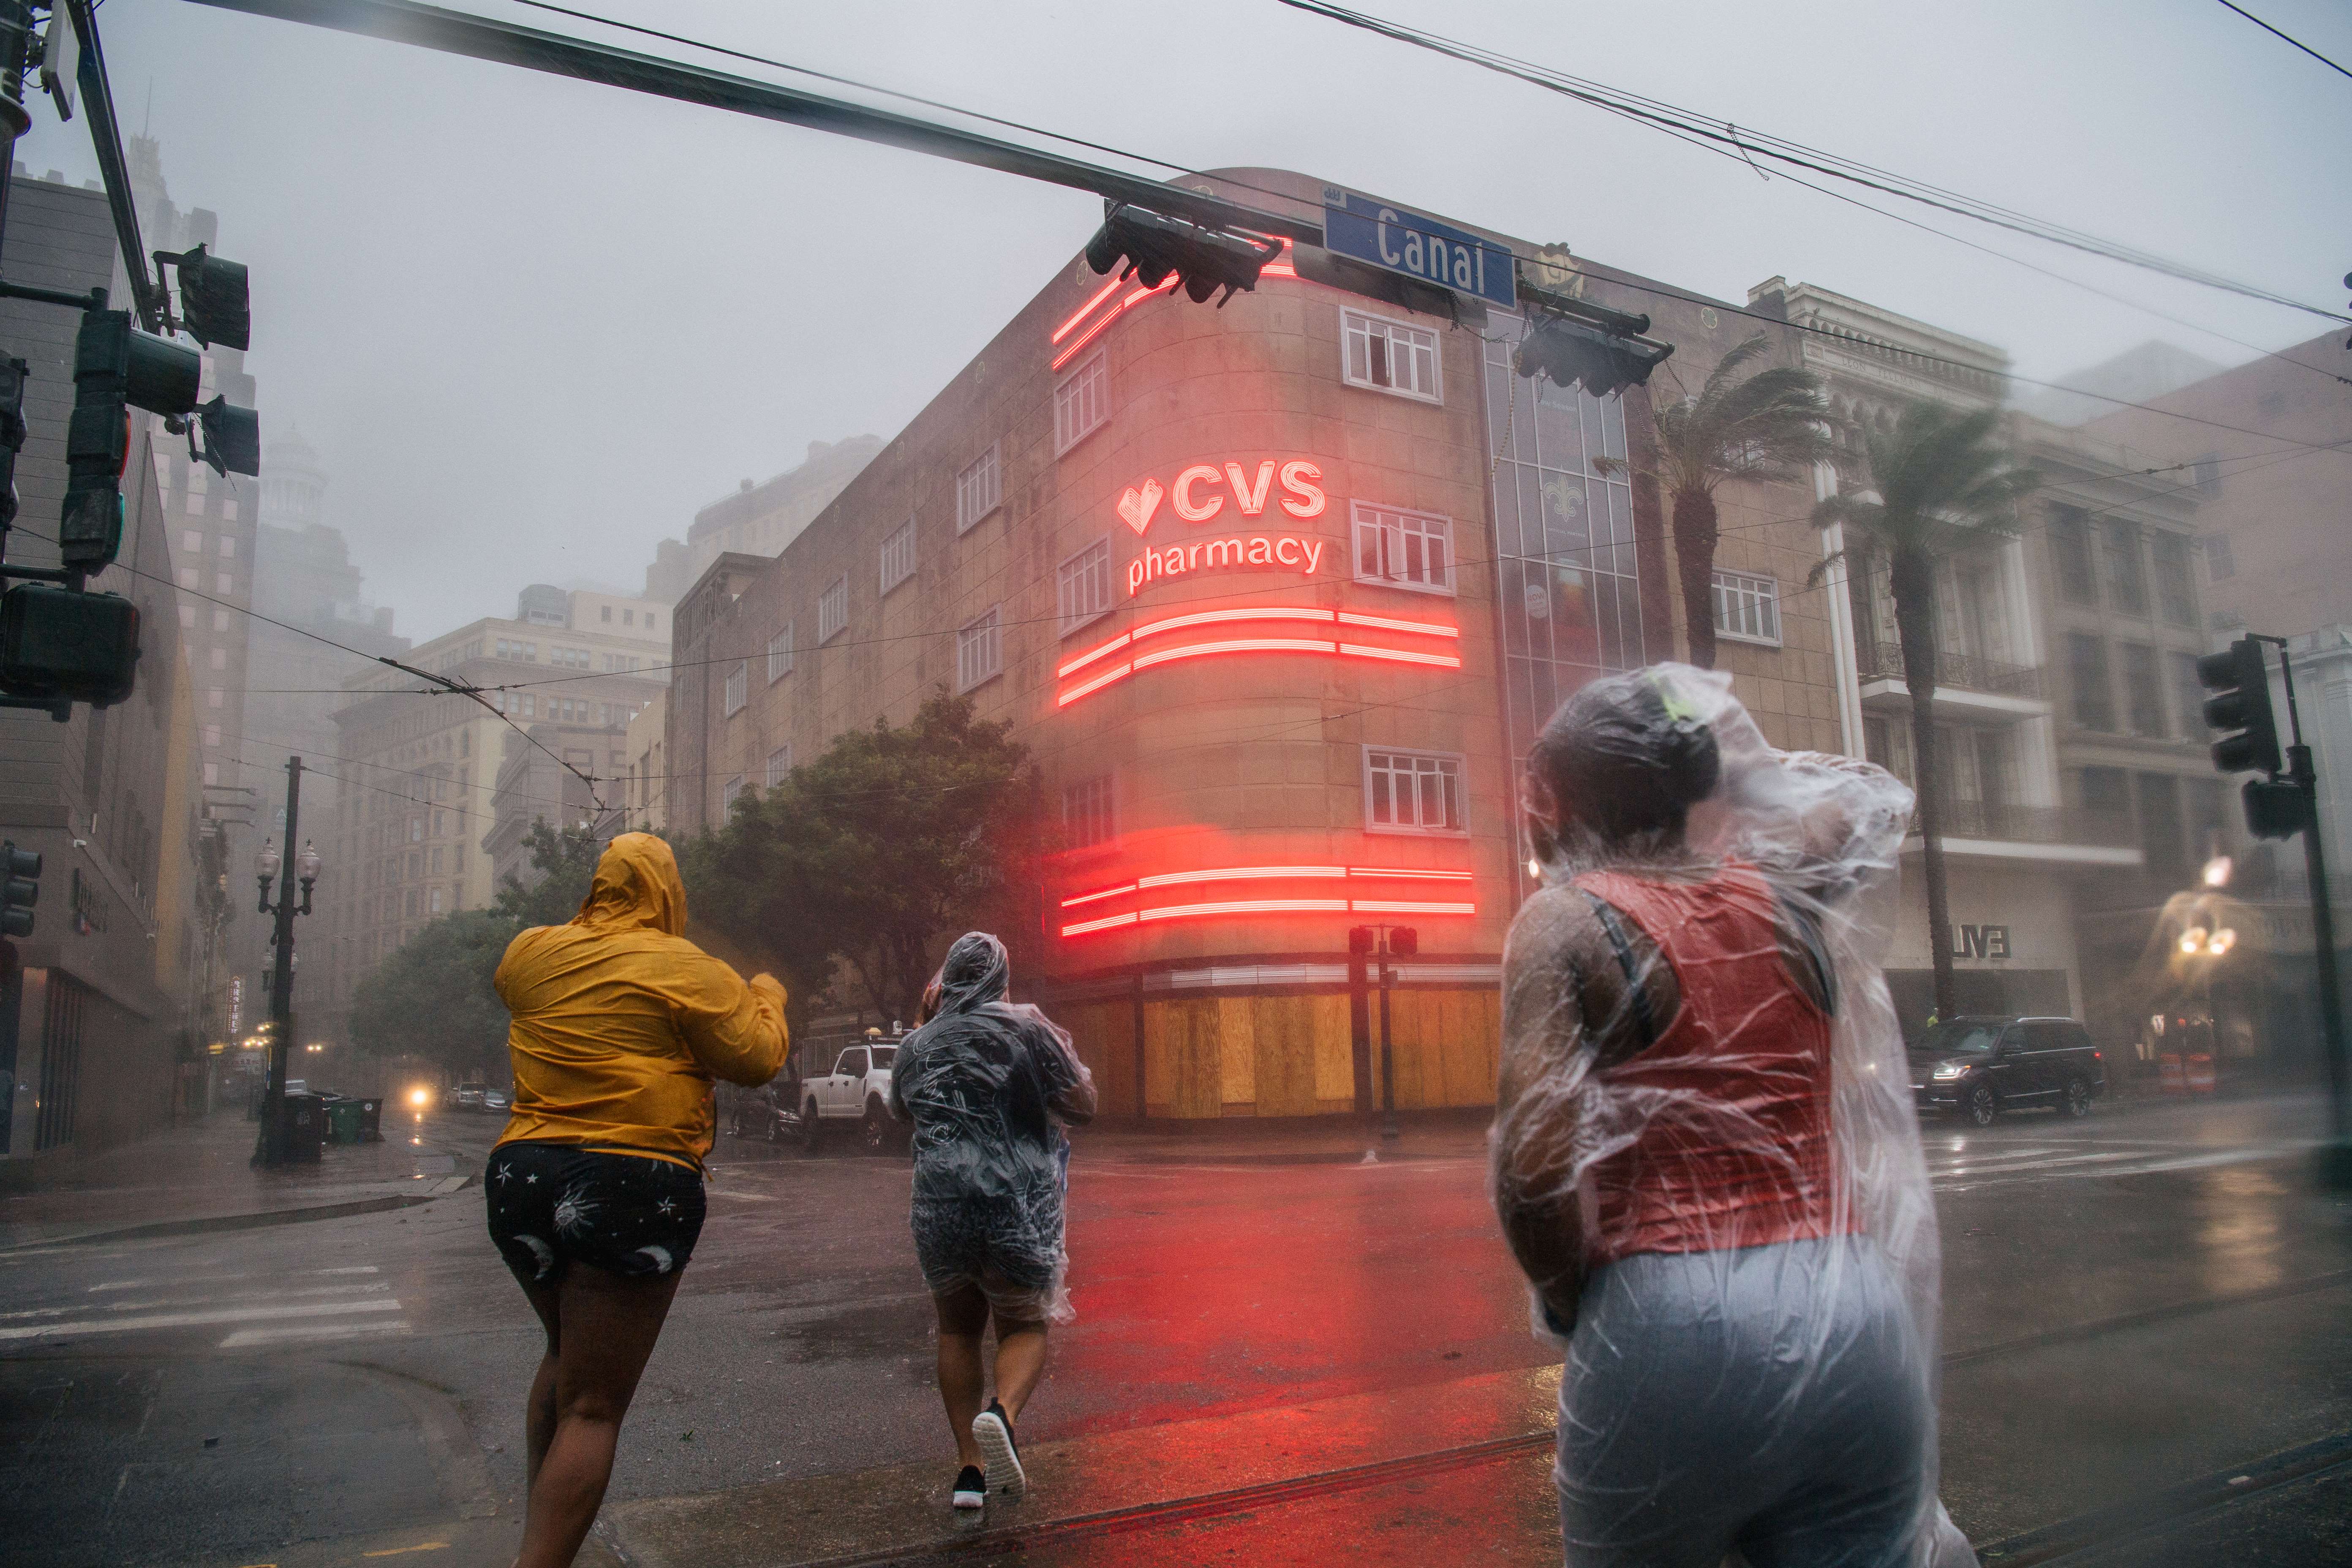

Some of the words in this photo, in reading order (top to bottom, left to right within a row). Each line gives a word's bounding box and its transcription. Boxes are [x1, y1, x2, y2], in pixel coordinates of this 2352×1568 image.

[1378, 208, 1485, 294] Canal
[1842, 357, 1866, 372] LEON
[1552, 401, 1577, 412] Season
[1172, 460, 1326, 521] CVS
[1128, 537, 1323, 596] pharmacy
